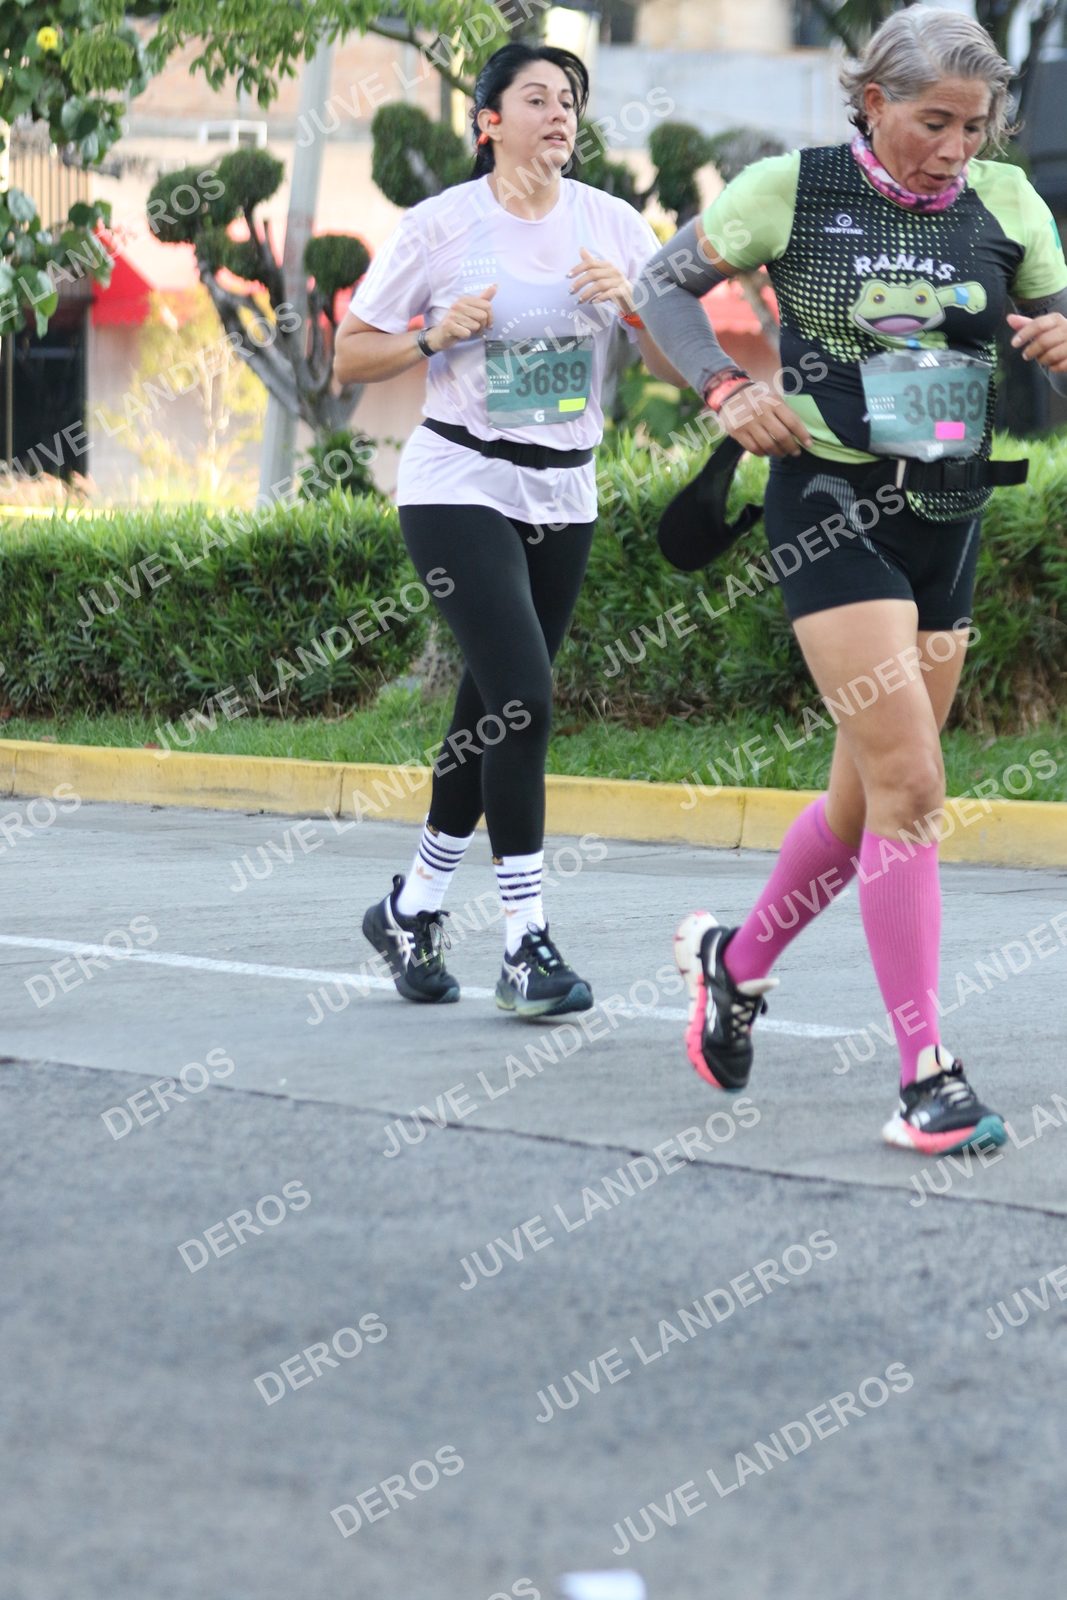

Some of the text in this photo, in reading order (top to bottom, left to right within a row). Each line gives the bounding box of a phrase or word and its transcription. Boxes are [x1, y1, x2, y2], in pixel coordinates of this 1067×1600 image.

[854, 254, 956, 281] RANAS
[516, 360, 587, 398] 3689
[903, 380, 985, 425] 3659
